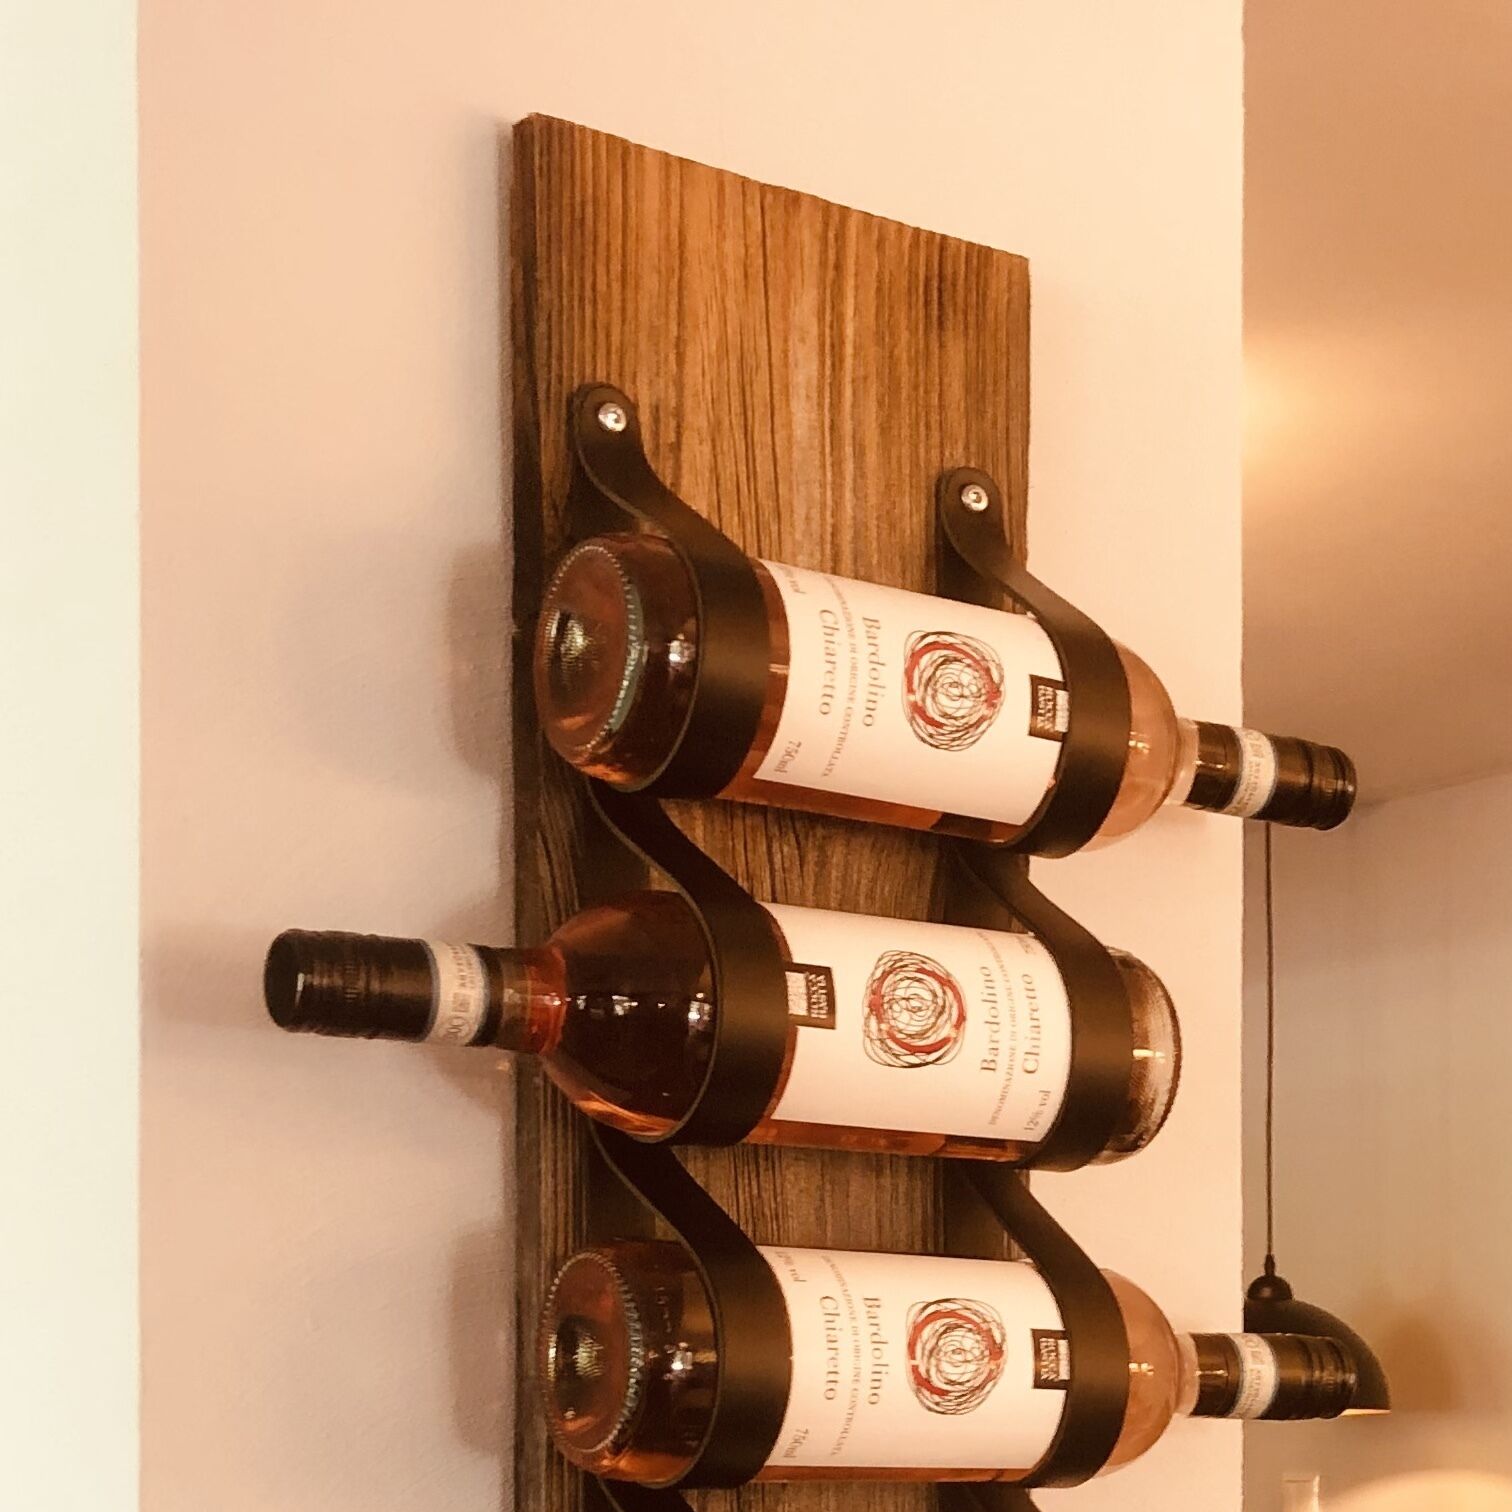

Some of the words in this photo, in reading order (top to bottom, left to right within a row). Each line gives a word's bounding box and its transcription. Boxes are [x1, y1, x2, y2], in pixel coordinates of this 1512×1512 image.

[818, 609, 842, 716] Chiaretto
[848, 656, 858, 704] ORIGINE
[862, 616, 887, 728] Bardolino
[773, 741, 802, 774] 750ml
[821, 706, 855, 777] CONTROLLATA
[978, 966, 1000, 1073] Bardolino
[1020, 973, 1041, 1075] Chiaretto
[1038, 1089, 1052, 1107] vol
[819, 1295, 844, 1401] Chiaretto
[863, 1296, 890, 1406] Bardolino
